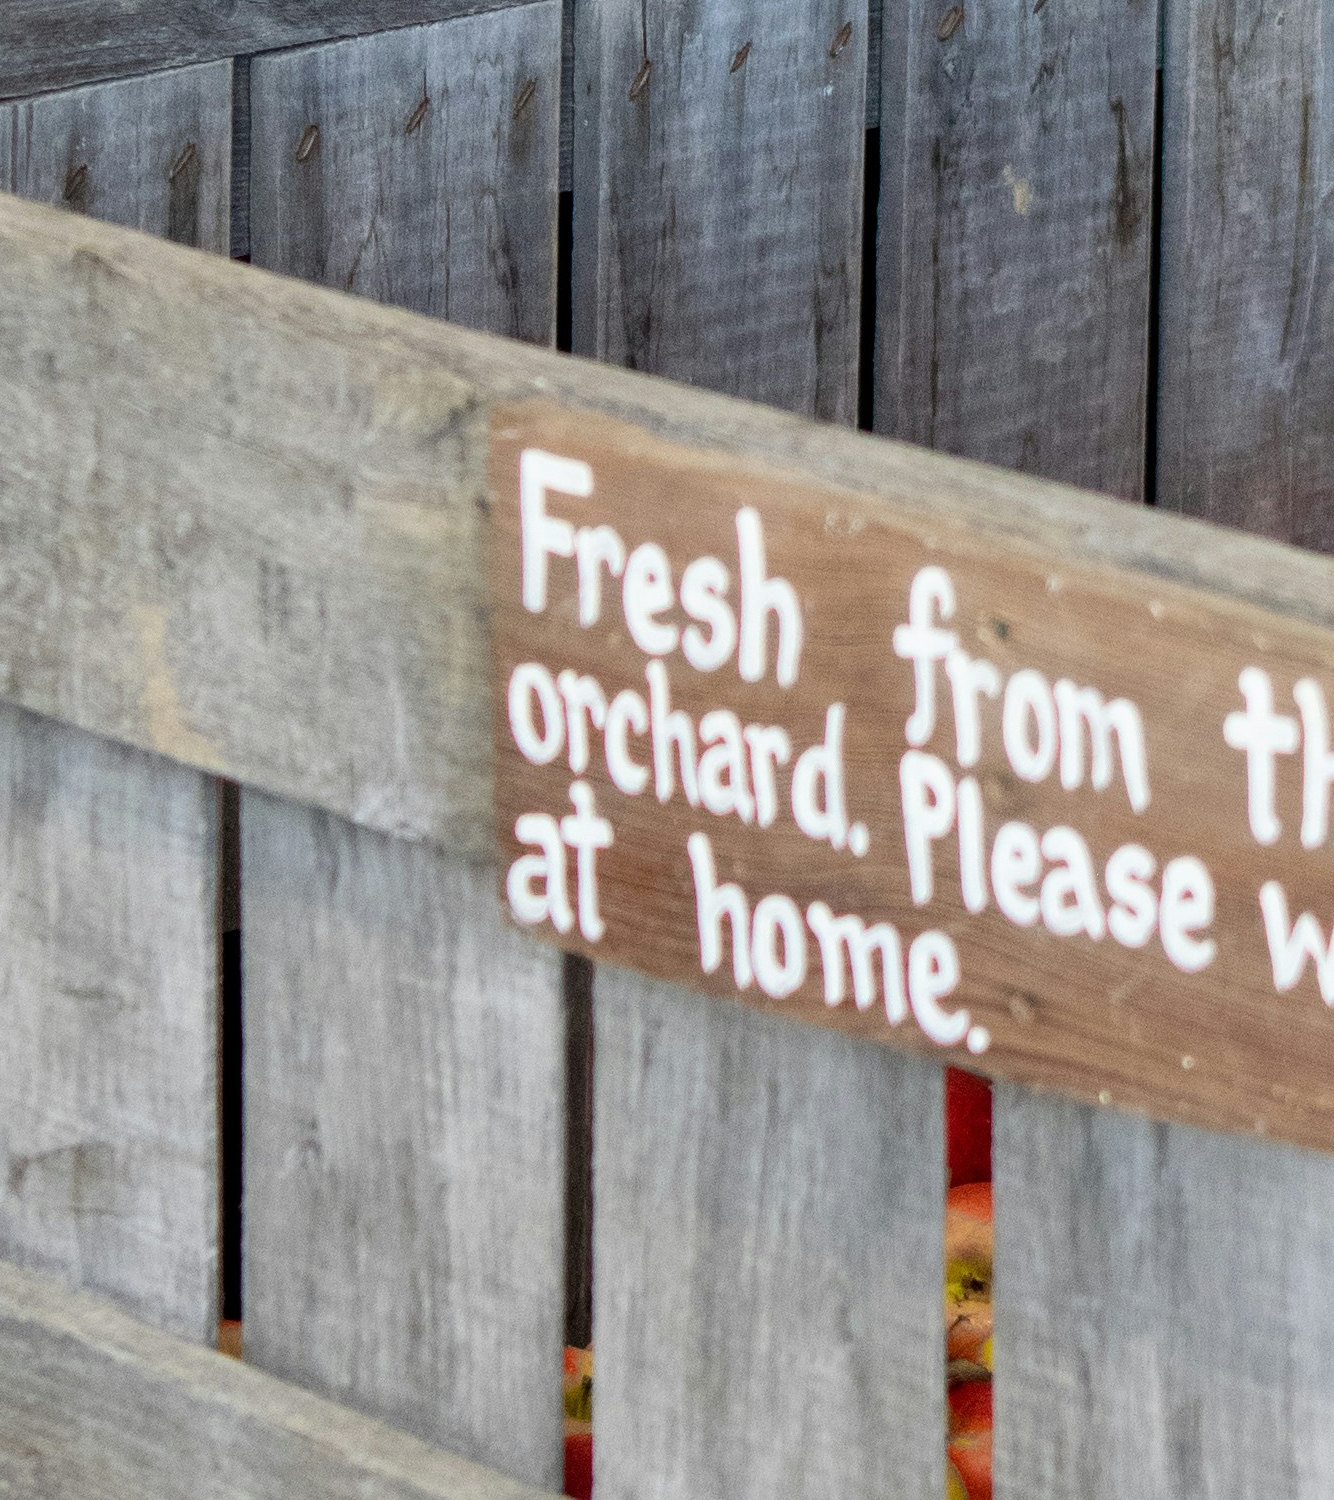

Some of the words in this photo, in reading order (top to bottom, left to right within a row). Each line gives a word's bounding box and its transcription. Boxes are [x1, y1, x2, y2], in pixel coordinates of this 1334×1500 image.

[508, 660, 870, 858] orchard.
[519, 448, 803, 688] Fresh
[893, 565, 1151, 814] from
[505, 780, 614, 942] at
[688, 831, 990, 1054] home.
